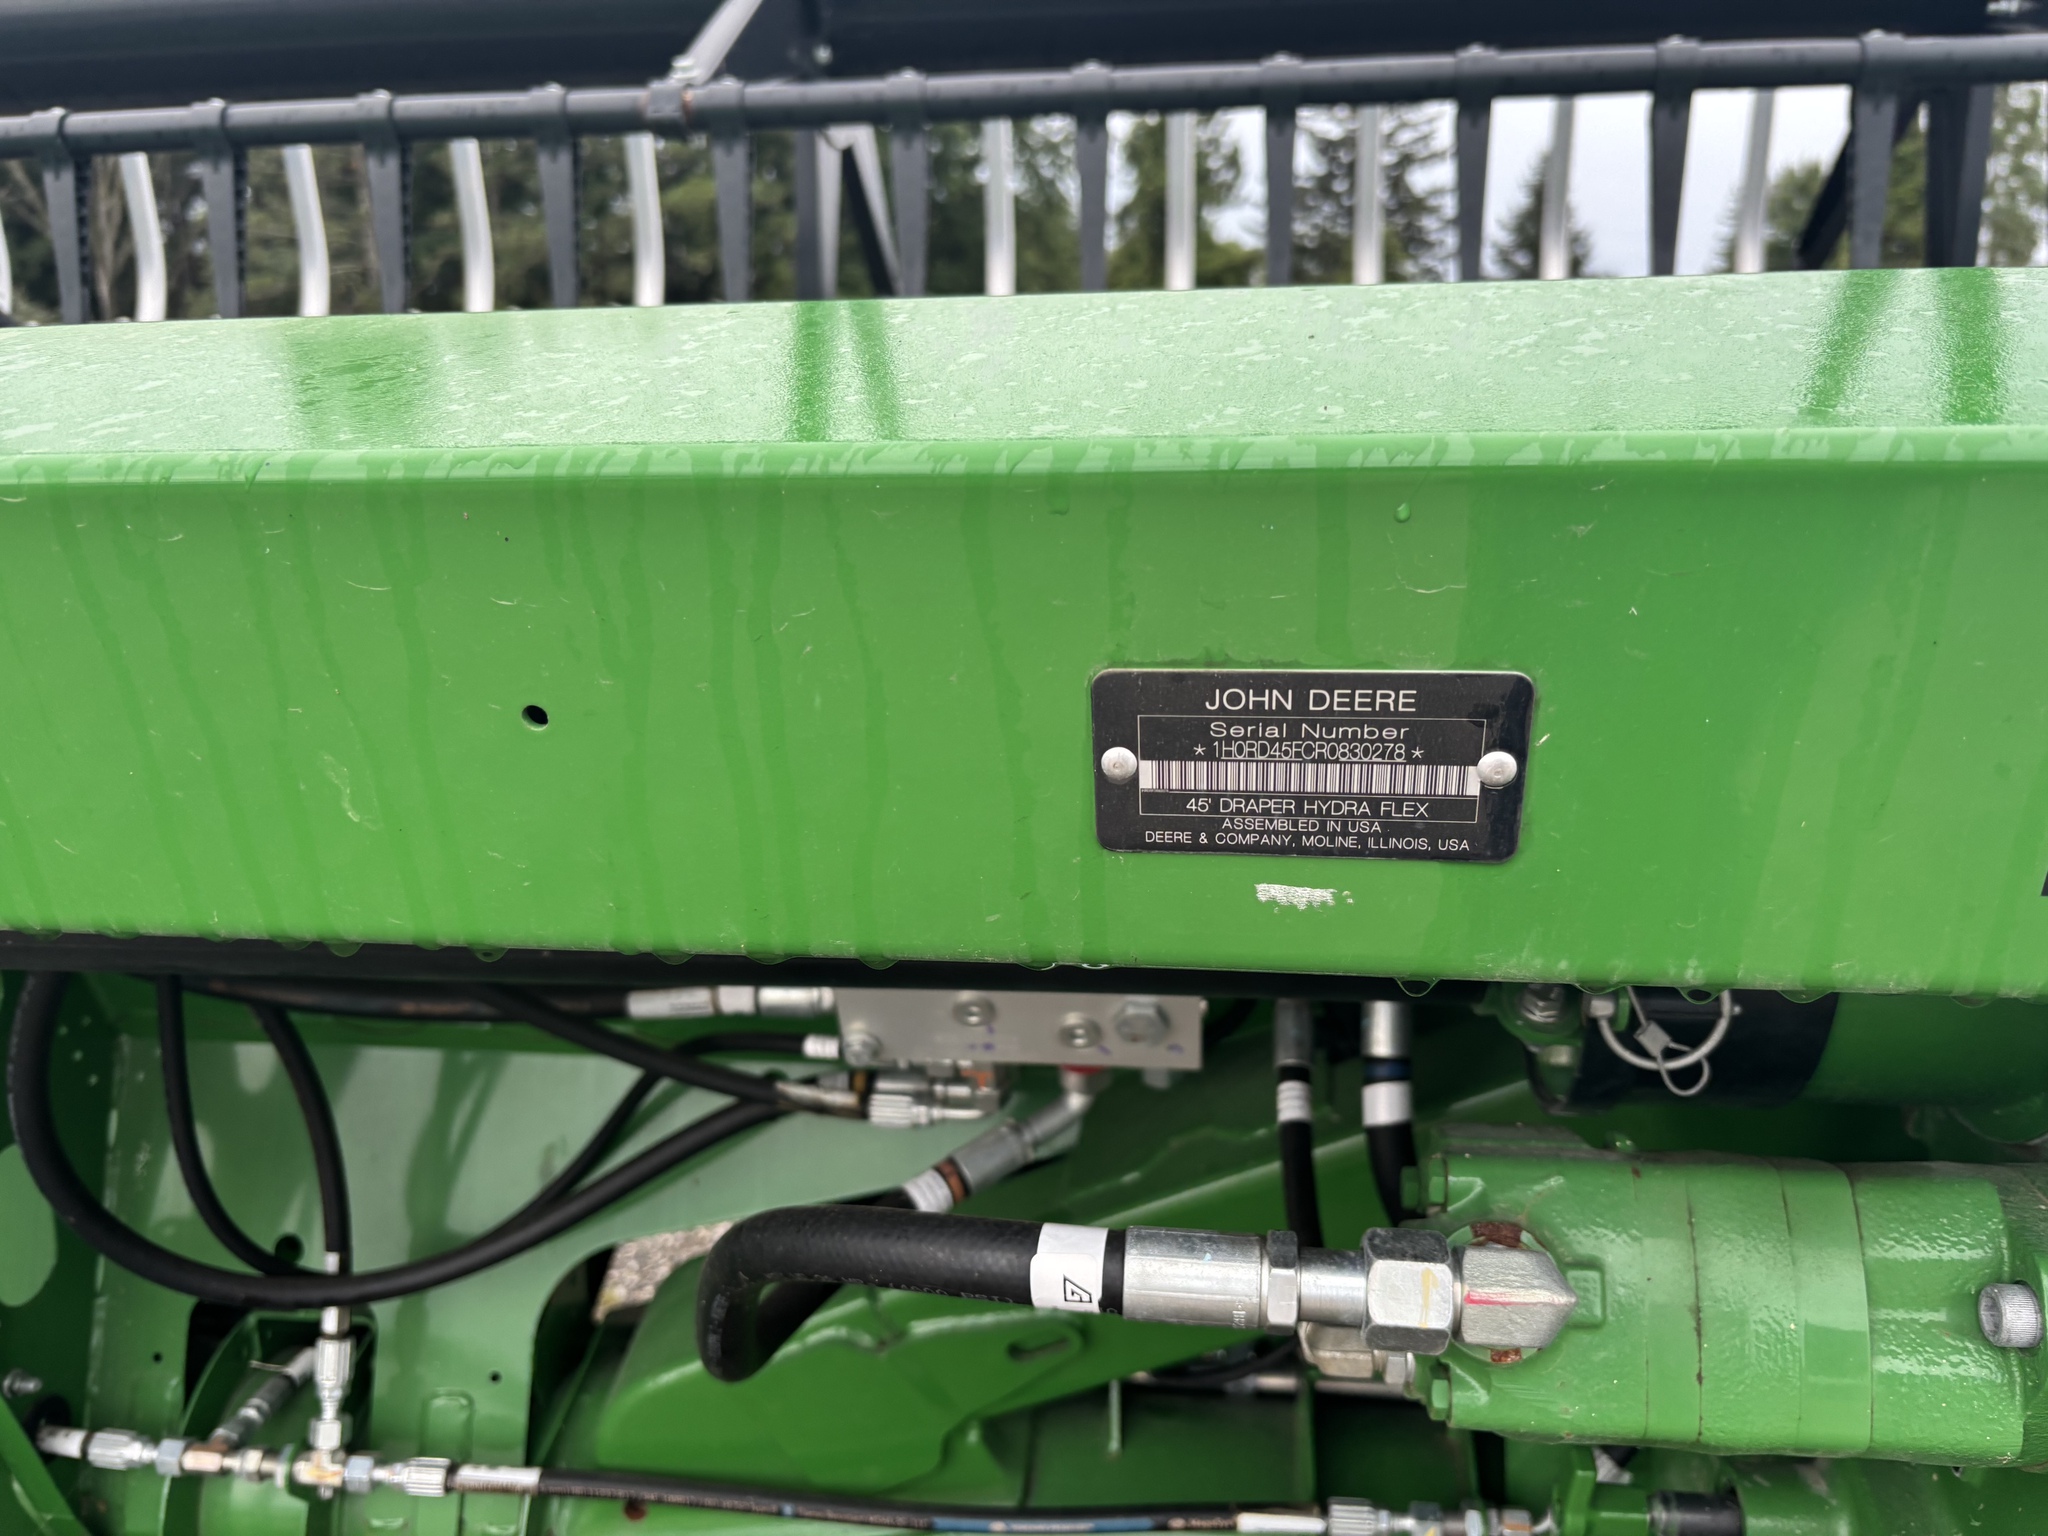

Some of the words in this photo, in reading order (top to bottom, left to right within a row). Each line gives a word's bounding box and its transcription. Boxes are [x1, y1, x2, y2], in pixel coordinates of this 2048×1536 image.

[1205, 689, 1292, 711] JOHN
[1309, 689, 1417, 711] DEERE
[1210, 722, 1286, 738] Serial
[1302, 723, 1409, 740] Number
[1186, 798, 1212, 813] 45'
[1220, 798, 1295, 814] DRAPER
[1304, 800, 1371, 816] HYDRA
[1380, 802, 1429, 817] FLEX
[1222, 818, 1319, 832] ASSEMBLED
[1327, 819, 1341, 832] IN
[1348, 820, 1382, 833] USA
[1145, 831, 1192, 844] DEERE
[1199, 832, 1208, 844] &
[1215, 833, 1296, 848] COMPANY,
[1302, 835, 1361, 849] MOLINE,
[1368, 837, 1431, 851] ILLINOIS,
[1438, 838, 1470, 851] USA
